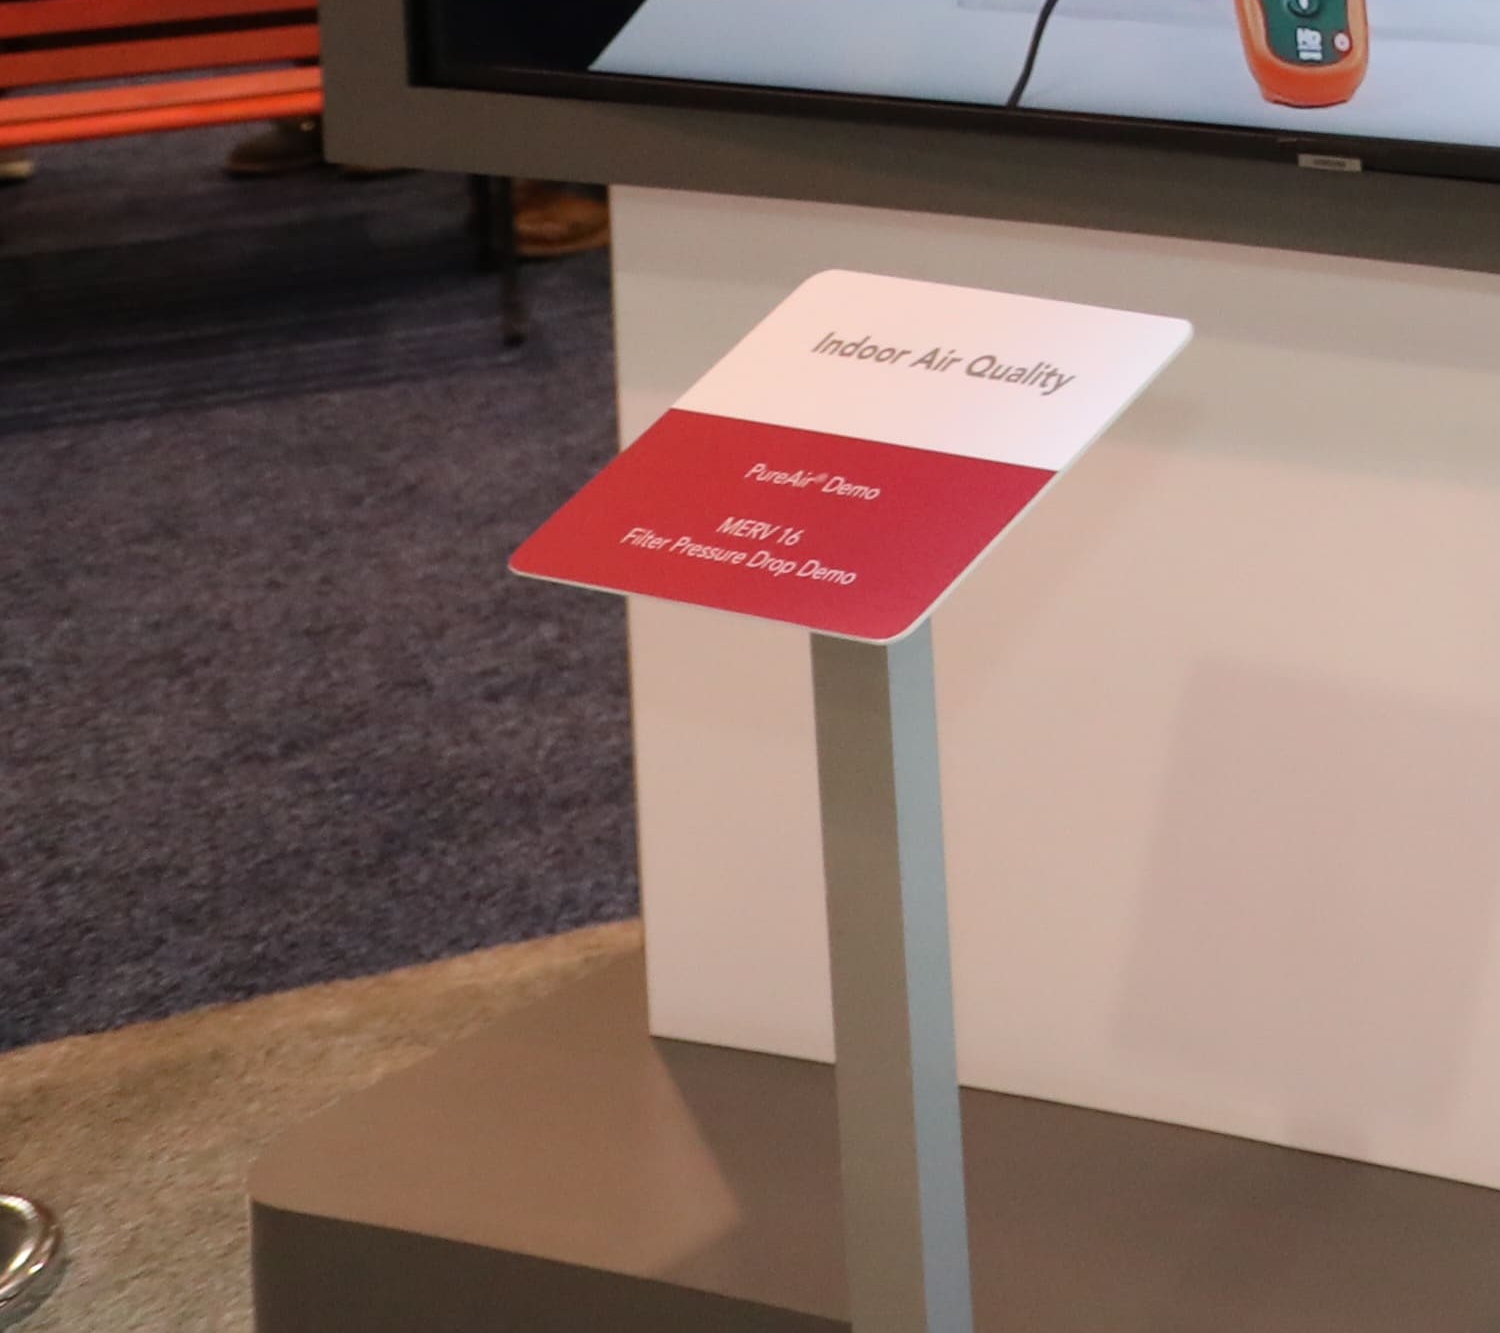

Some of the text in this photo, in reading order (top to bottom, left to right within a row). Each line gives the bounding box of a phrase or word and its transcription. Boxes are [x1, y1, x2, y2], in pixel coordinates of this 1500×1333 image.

[810, 331, 1077, 397] Indoor Air Quality
[822, 476, 881, 501] Demo
[716, 516, 805, 546] MERV 16
[620, 527, 858, 586] Filter Pressure Drop Demo
